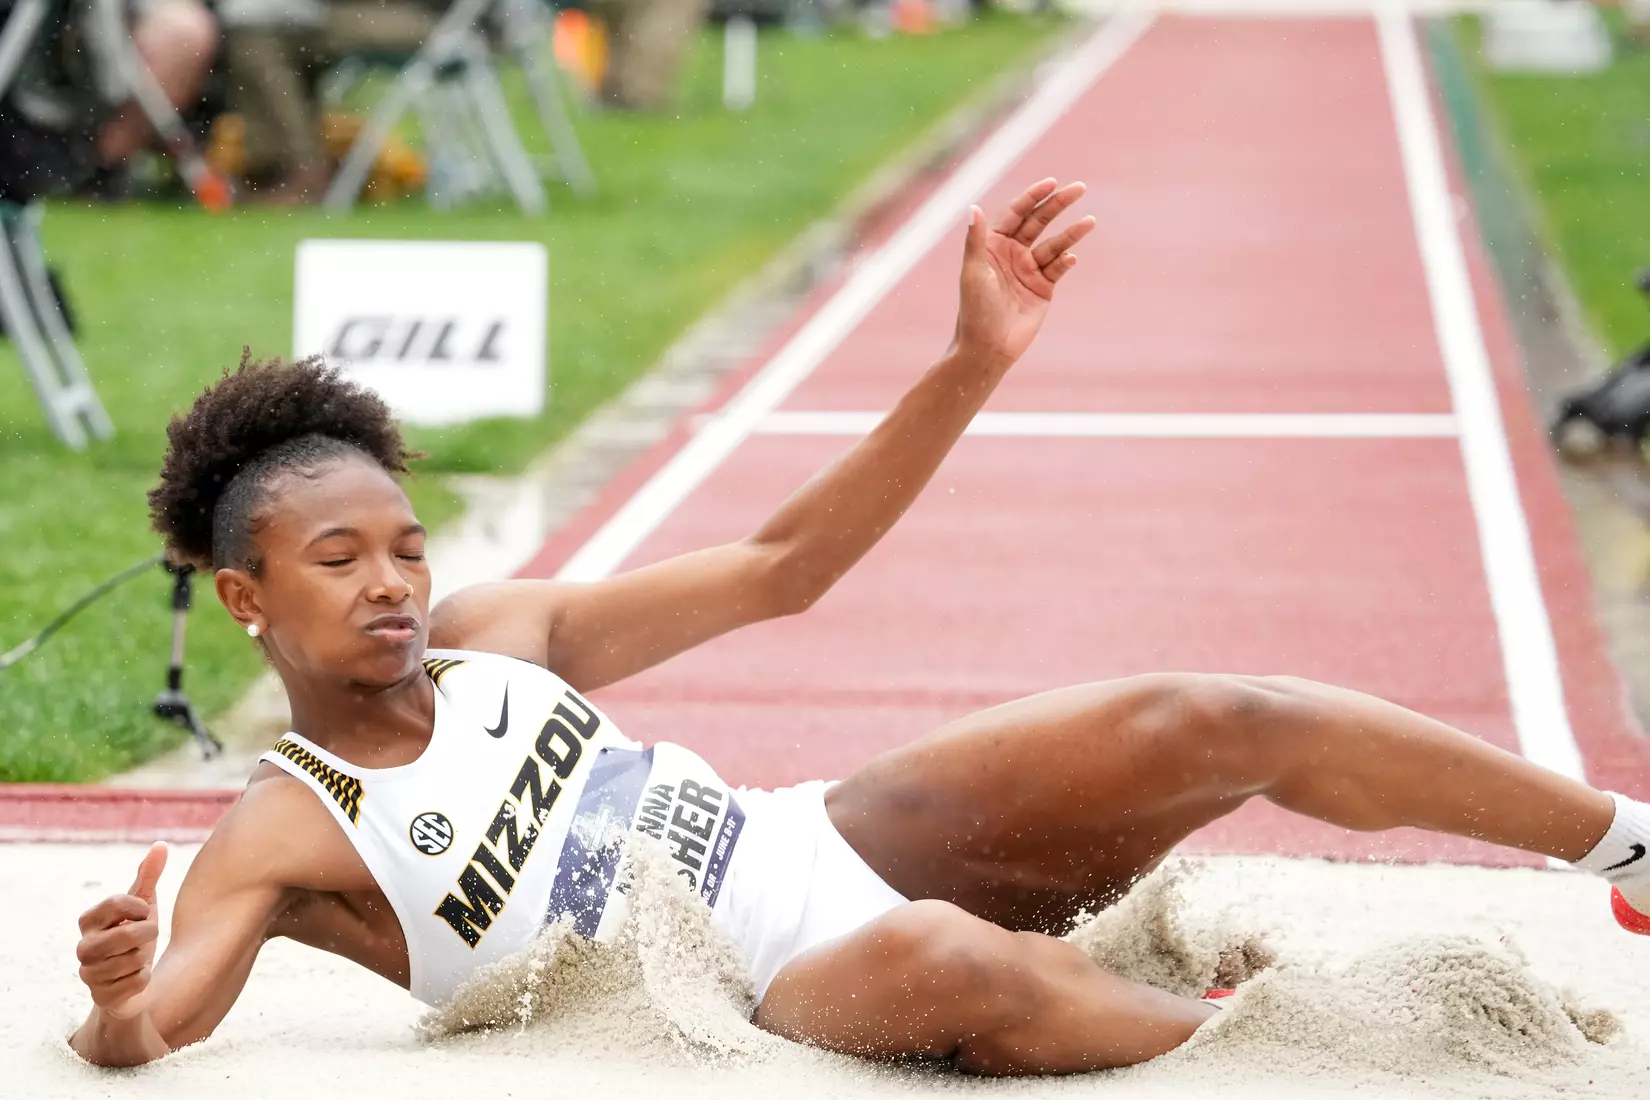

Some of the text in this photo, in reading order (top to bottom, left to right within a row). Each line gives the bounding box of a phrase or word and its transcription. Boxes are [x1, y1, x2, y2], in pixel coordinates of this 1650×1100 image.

[328, 315, 505, 360] GILL
[411, 813, 453, 855] SEC
[434, 689, 600, 950] MIZZOU
[716, 835, 730, 860] JUNE
